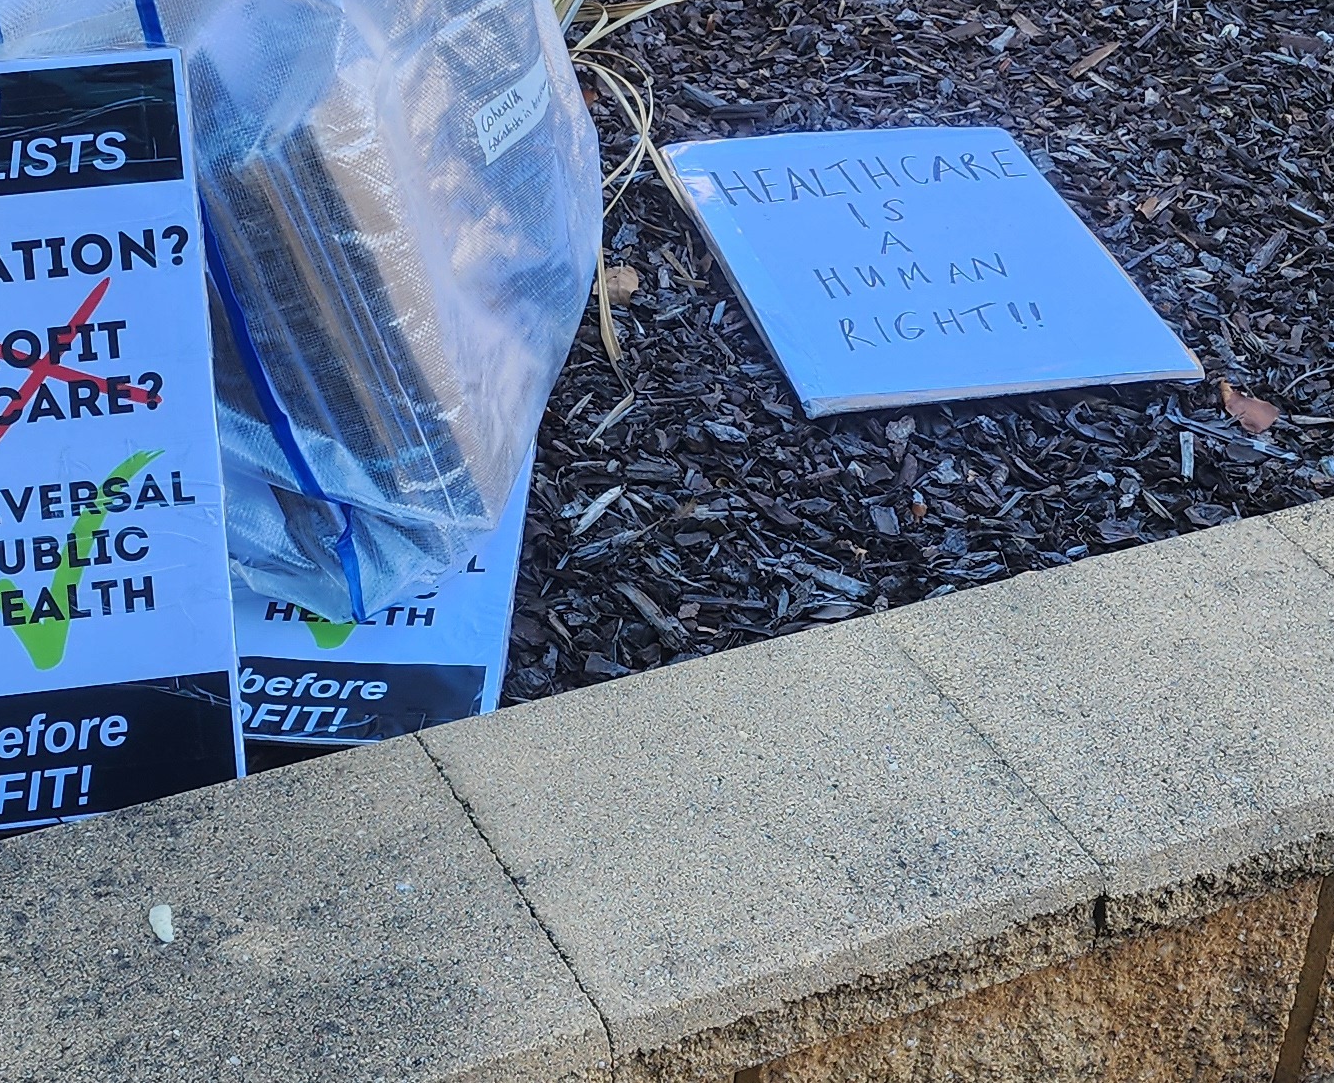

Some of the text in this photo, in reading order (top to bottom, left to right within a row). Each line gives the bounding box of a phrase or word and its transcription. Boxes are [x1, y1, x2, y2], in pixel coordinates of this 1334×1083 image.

[709, 148, 1028, 208] HEALTHCARE
[846, 198, 905, 229] IS
[880, 231, 914, 256] A
[812, 252, 1008, 300] HUMAN
[837, 301, 1044, 353] RIGHT!!
[238, 668, 388, 700] before
